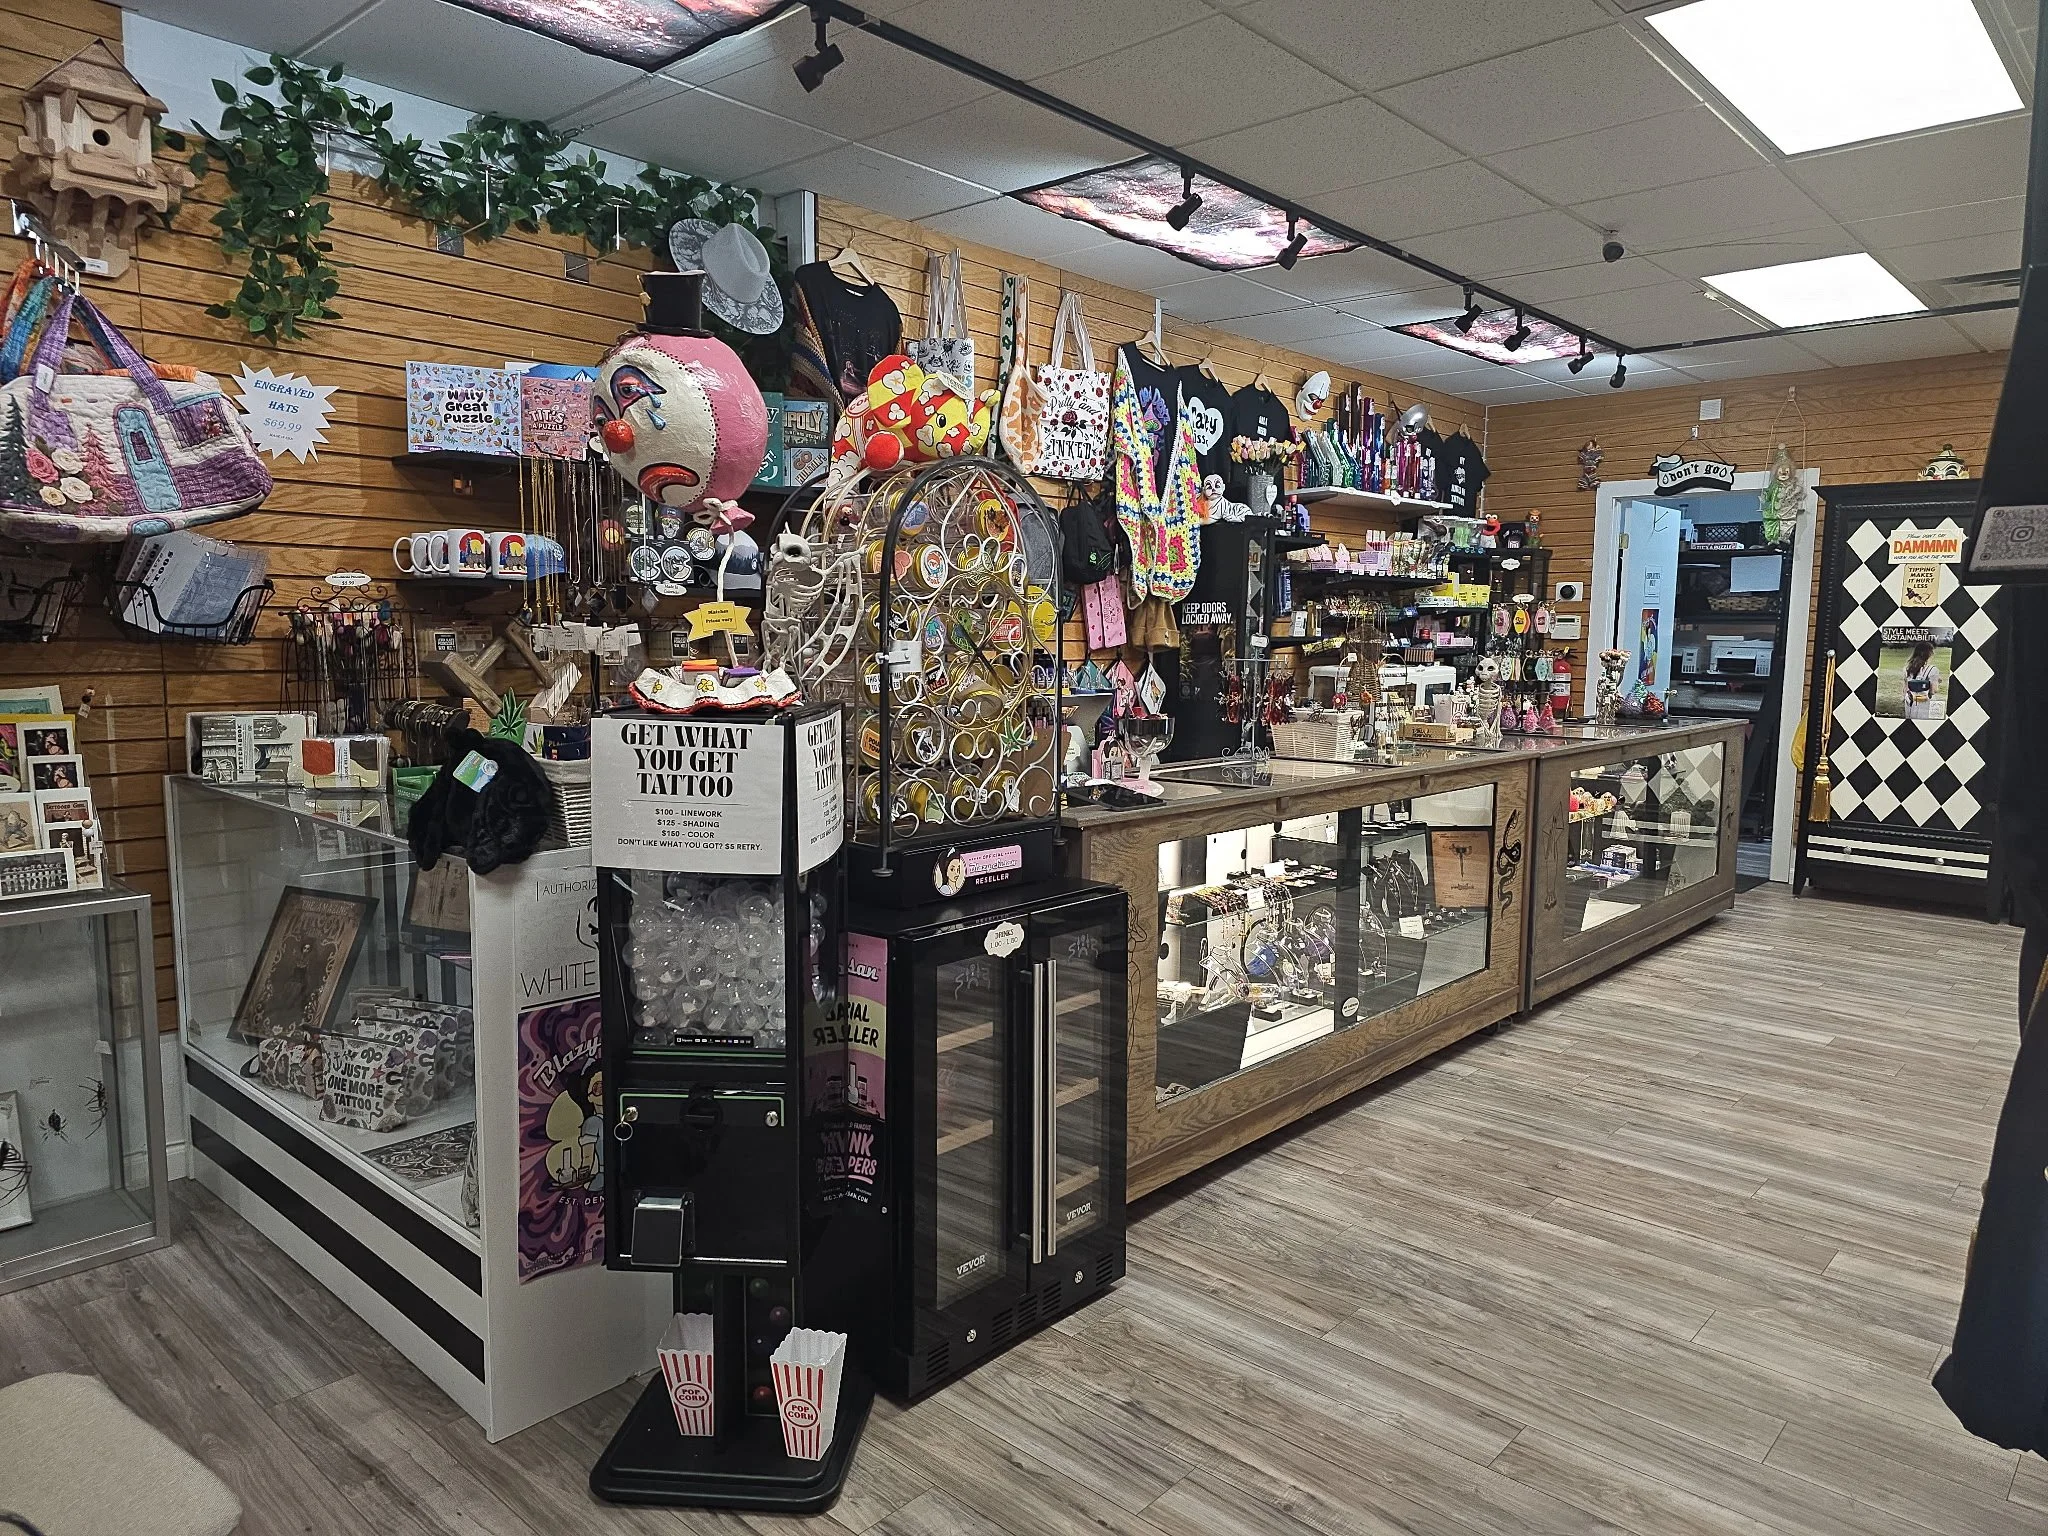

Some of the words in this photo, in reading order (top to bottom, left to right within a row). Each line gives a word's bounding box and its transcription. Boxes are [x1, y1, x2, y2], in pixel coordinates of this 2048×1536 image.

[254, 379, 315, 399] ENGRAVED
[268, 400, 299, 414] HATS
[445, 401, 489, 412] Great
[1049, 395, 1076, 416] Pretty
[1079, 400, 1101, 416] and
[263, 417, 302, 433] $69.99
[444, 413, 494, 424] Puzzle
[538, 423, 563, 431] PUZZLE
[1050, 438, 1092, 459] INKED
[1669, 464, 1699, 481] don't
[1704, 464, 1720, 475] go
[1893, 539, 1958, 554] DAMMMN
[1182, 603, 1200, 613] KEEP
[1201, 602, 1227, 613] ODORS
[1182, 613, 1209, 625] LOCKED
[1210, 612, 1234, 624] AWAY.
[621, 722, 669, 746] GET
[673, 725, 753, 750] WHAT
[807, 722, 823, 747] GET
[633, 748, 683, 772] YOU
[689, 750, 739, 773] GET
[812, 744, 829, 769] YOU
[636, 772, 734, 798] TATTOO
[655, 808, 674, 816] $100
[681, 809, 723, 818] LINEWORK
[657, 819, 676, 827] $125
[682, 820, 720, 828] SHADING
[687, 831, 715, 839] COLOR
[617, 838, 641, 846] DON'T
[642, 839, 658, 847] LIKE
[659, 840, 683, 848] WHAT
[685, 841, 701, 849] YOU
[702, 841, 723, 850] GOT?
[736, 843, 763, 851] RETRY.
[975, 872, 1010, 885] RESELLER
[542, 878, 598, 896] AUTHORIZ
[520, 960, 596, 998] WHITE
[533, 1036, 602, 1088] Blazy
[341, 1062, 370, 1080] JUST
[327, 1074, 347, 1092] ONE
[348, 1080, 384, 1098] MORE
[333, 1092, 372, 1111] TATTOO
[558, 1195, 579, 1206] EST.
[584, 1195, 605, 1206] DEN
[1066, 1202, 1092, 1221] VEVOR
[956, 1254, 986, 1275] VEVOR
[681, 1388, 701, 1396] POP
[788, 1411, 814, 1421] CORN
[791, 1404, 810, 1413] POP
